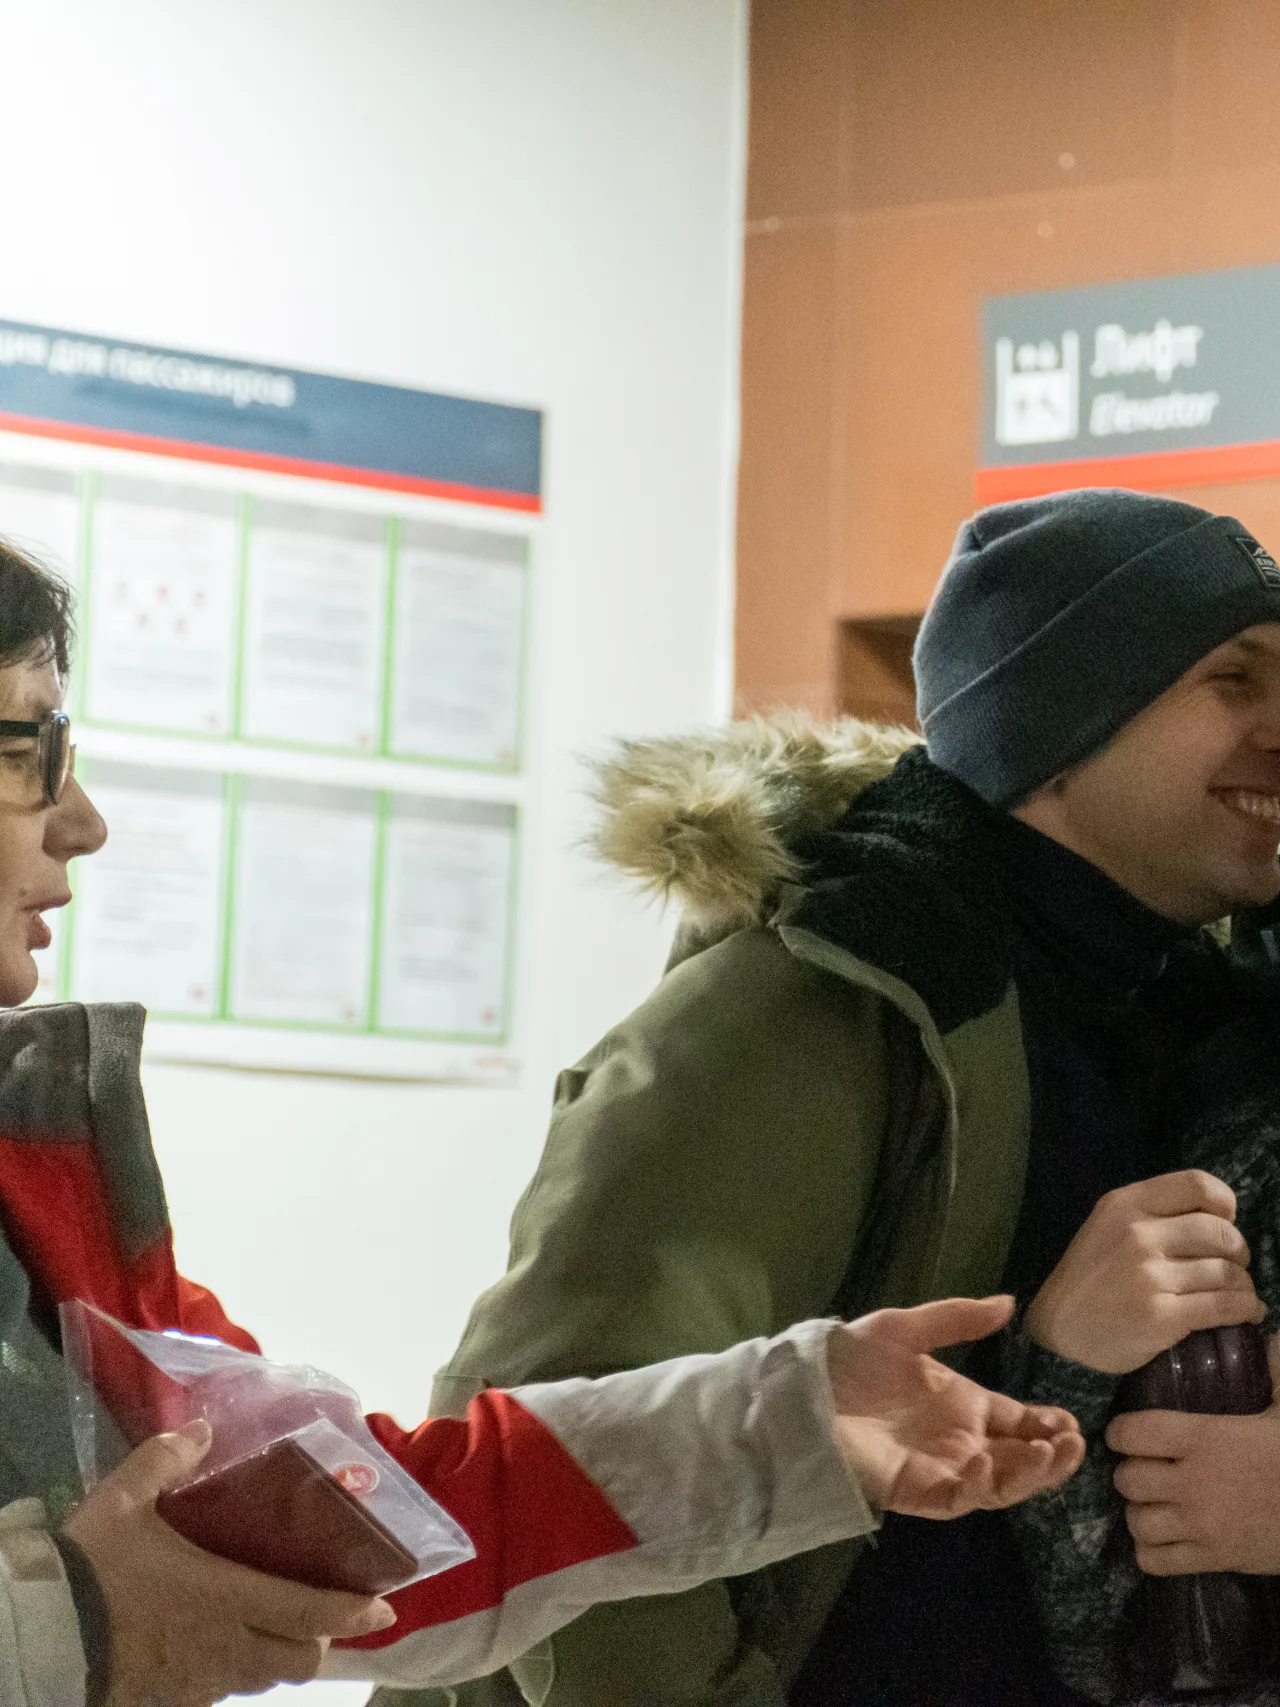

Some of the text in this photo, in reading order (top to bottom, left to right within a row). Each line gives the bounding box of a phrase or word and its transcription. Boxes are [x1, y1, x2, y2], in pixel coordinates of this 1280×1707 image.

[48, 338, 108, 377] для
[110, 347, 296, 408] пассажиров
[1091, 318, 1203, 383] Лифт
[1089, 390, 1220, 436] Elevator
